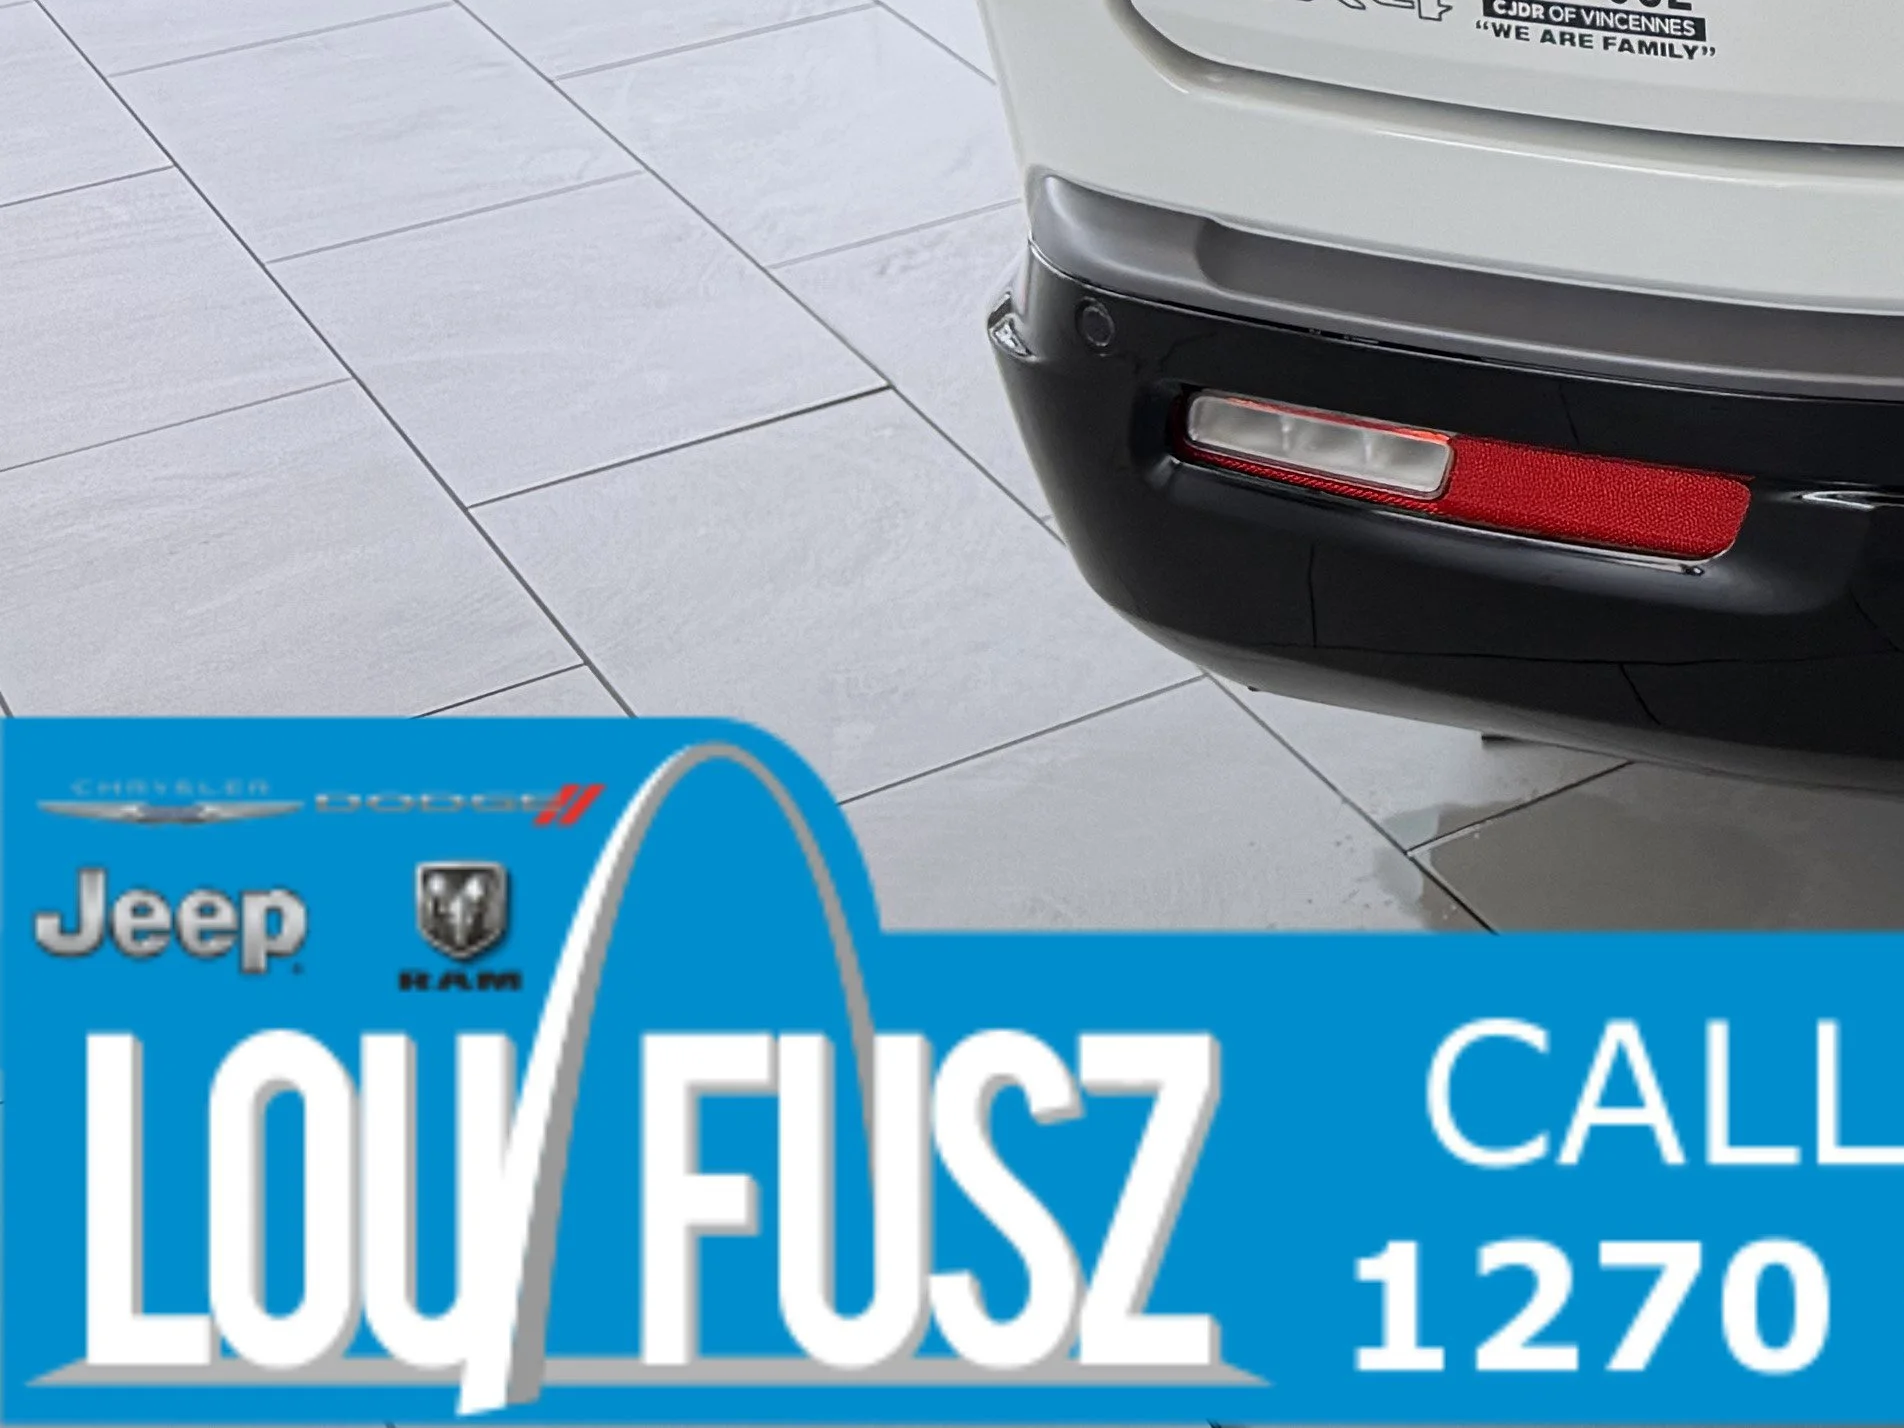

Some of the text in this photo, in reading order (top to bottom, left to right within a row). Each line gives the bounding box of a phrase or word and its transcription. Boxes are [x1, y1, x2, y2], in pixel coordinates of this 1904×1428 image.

[1548, 5, 1577, 24] OF
[1579, 9, 1696, 37] VINCENNES
[1539, 28, 1595, 50] ARE
